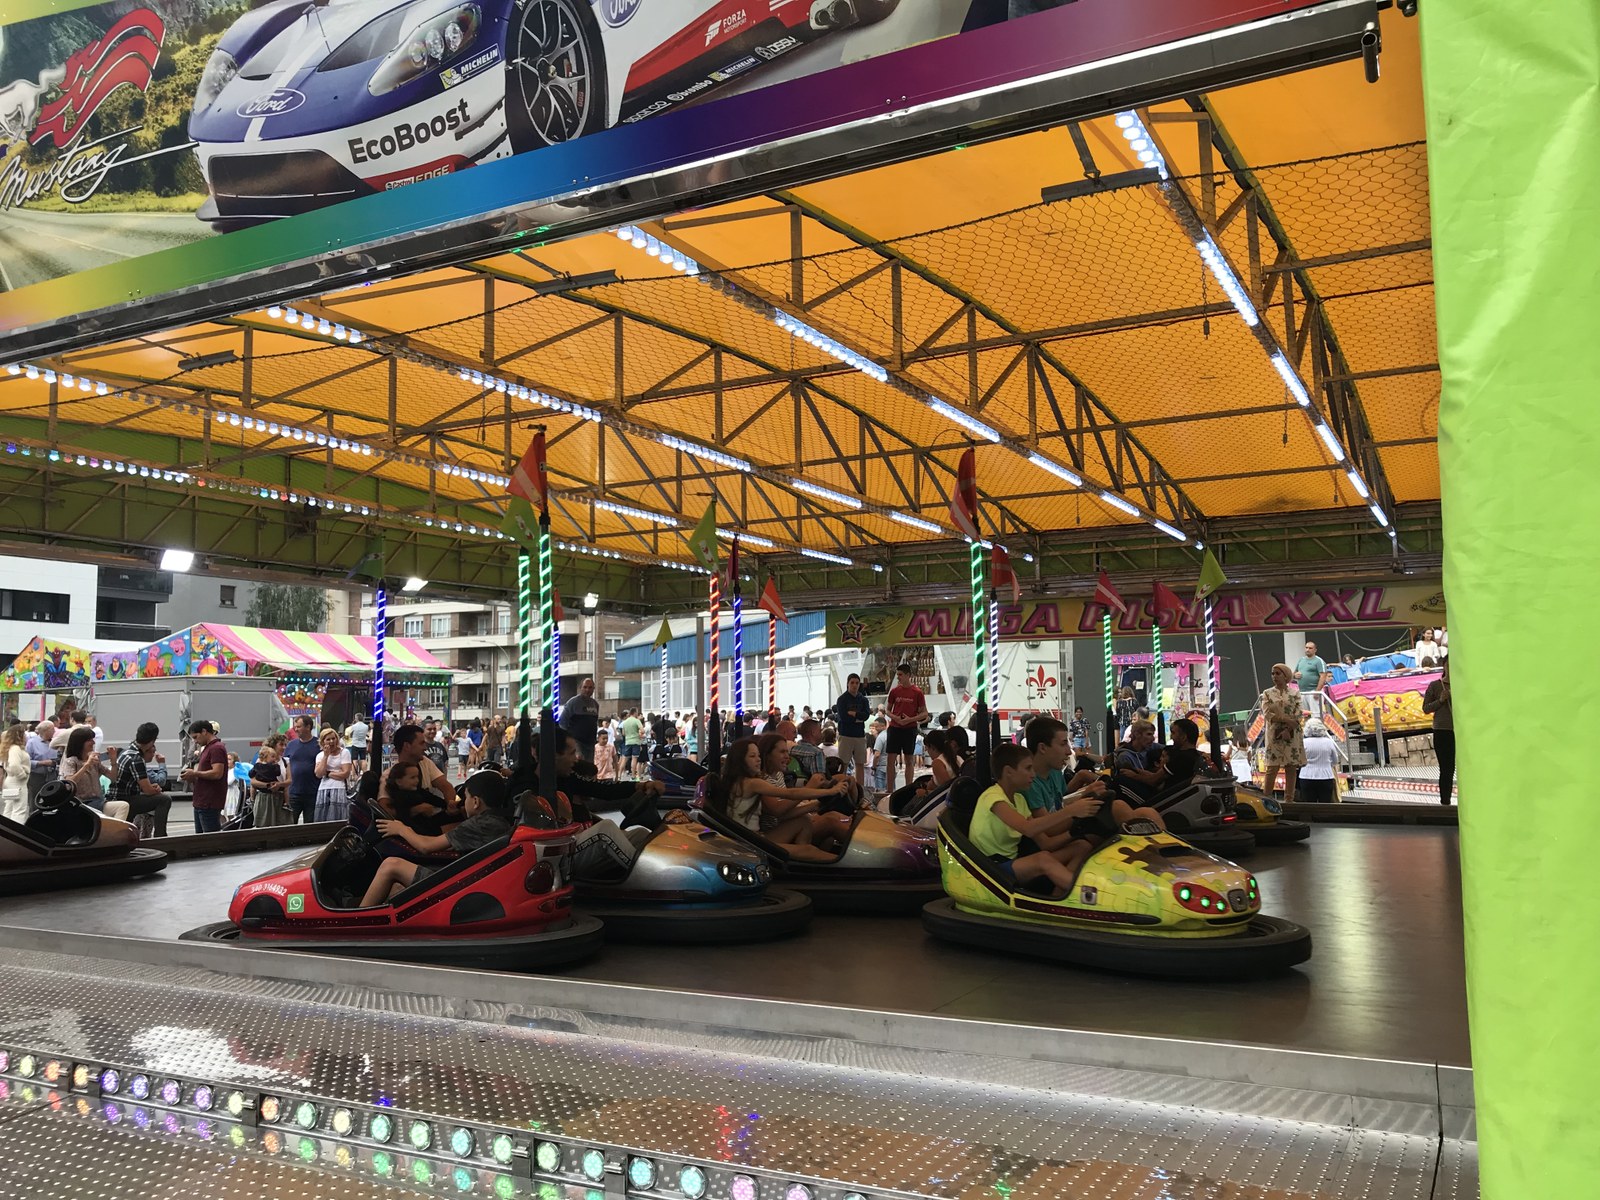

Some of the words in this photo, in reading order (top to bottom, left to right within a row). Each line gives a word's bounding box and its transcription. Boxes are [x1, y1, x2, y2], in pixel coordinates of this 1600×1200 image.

[723, 9, 746, 28] FORZA
[461, 49, 498, 74] MICHELIN
[725, 57, 756, 74] MICHELIN
[246, 92, 293, 114] Ford
[348, 98, 471, 164] EcoBoost
[0, 126, 199, 211] Mustang
[416, 164, 450, 182] EDGE
[1265, 587, 1395, 625] XXL
